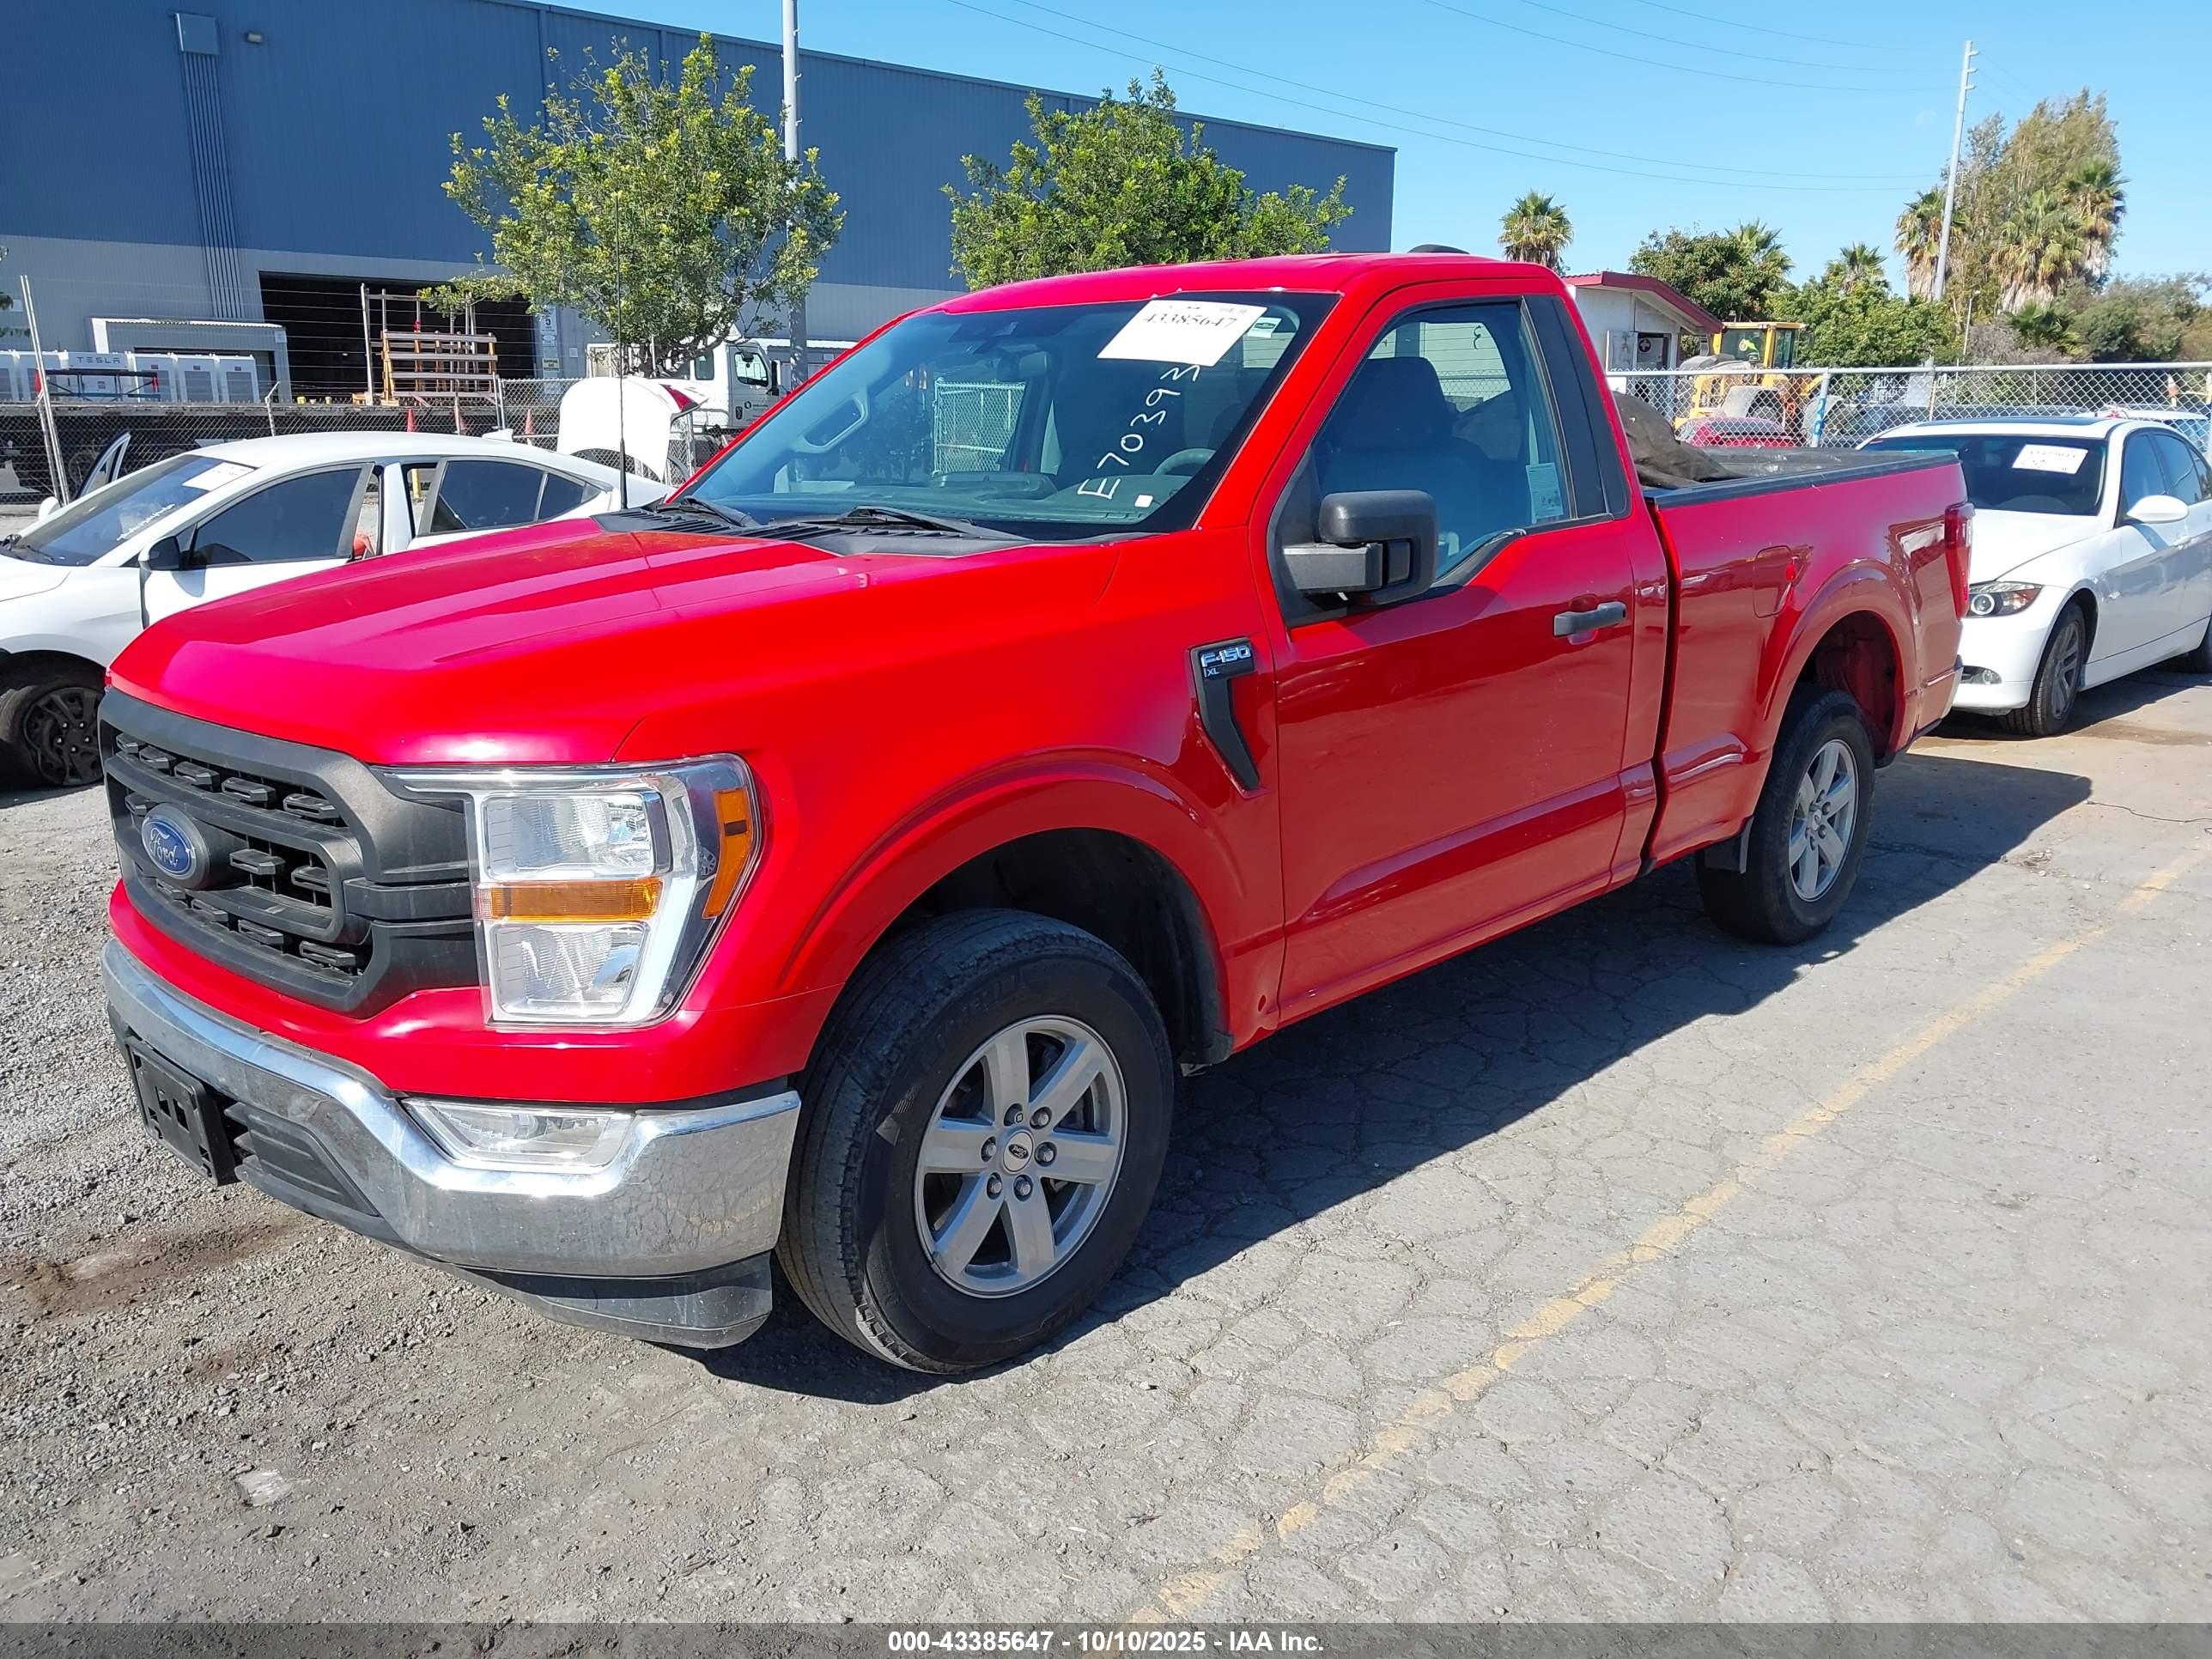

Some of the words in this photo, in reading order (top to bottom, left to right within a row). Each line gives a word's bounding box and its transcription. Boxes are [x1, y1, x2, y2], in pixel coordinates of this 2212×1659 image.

[1077, 363, 1200, 500] E70393
[1200, 646, 1251, 667] F-150
[149, 827, 179, 866] Ford
